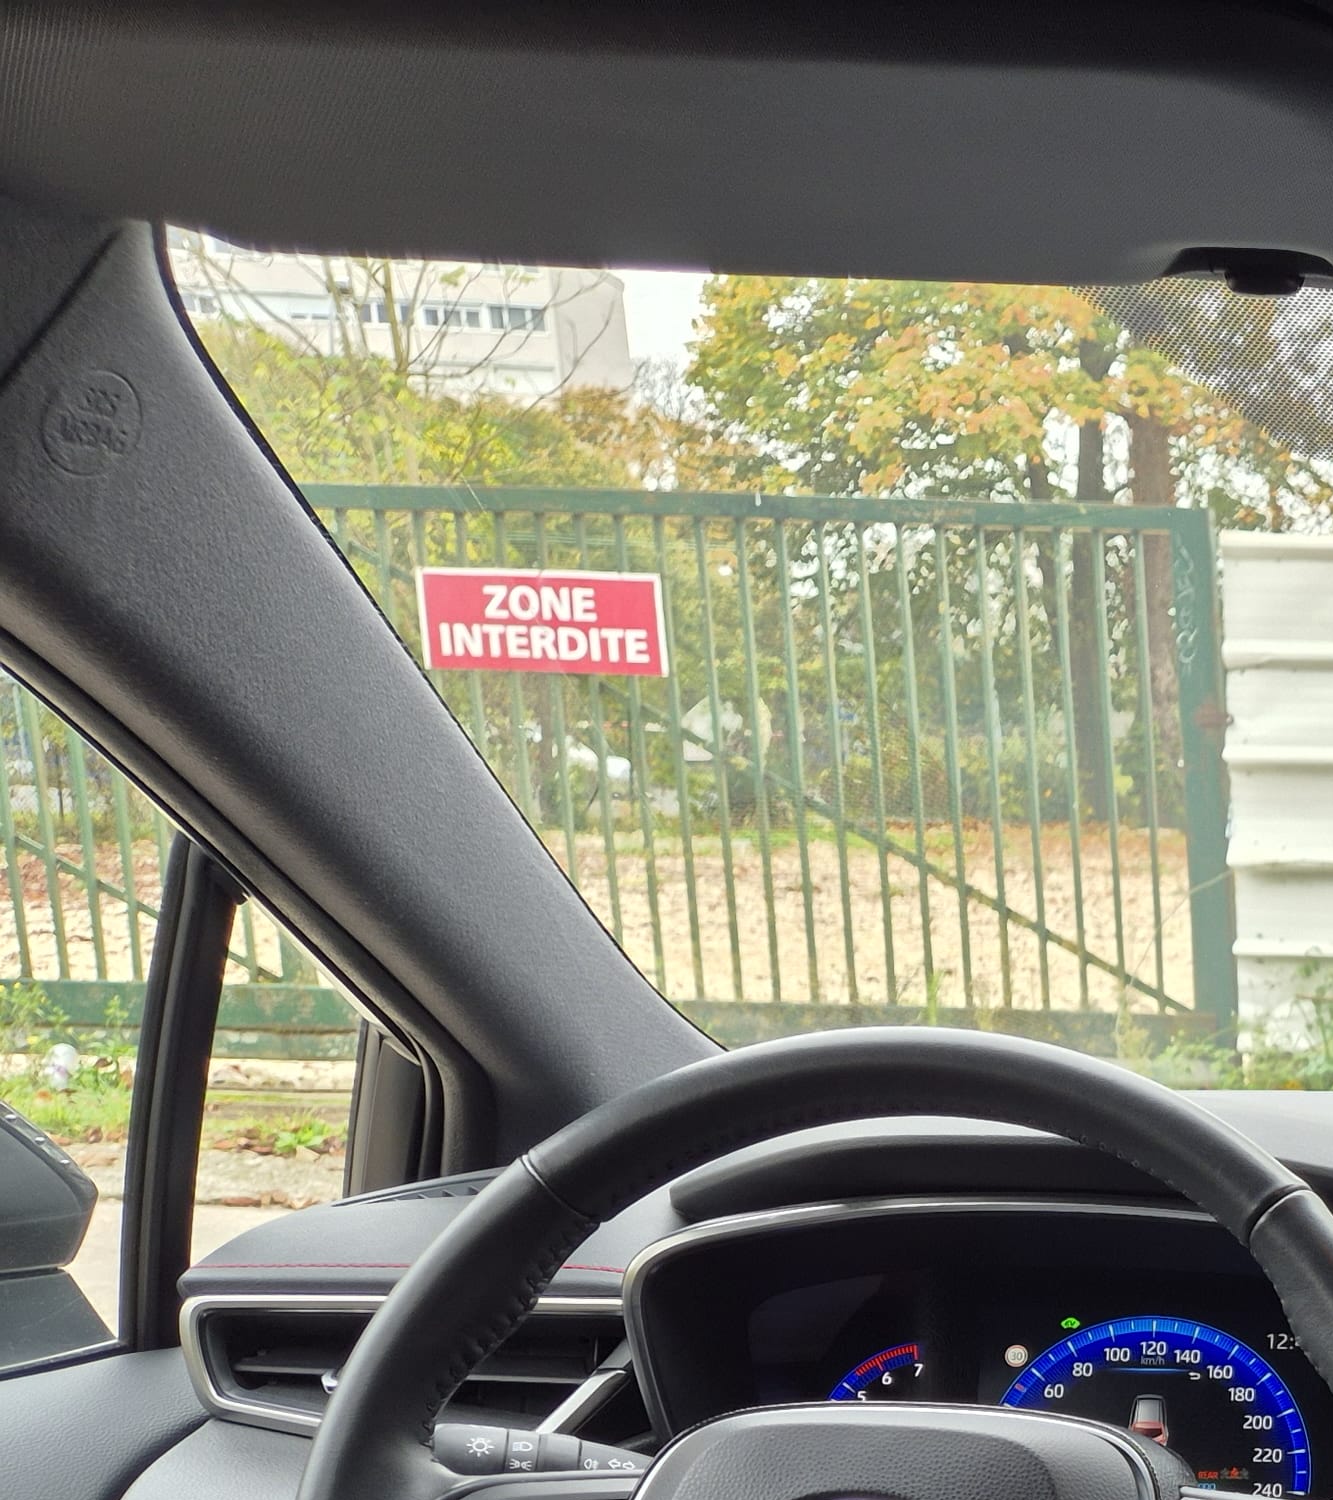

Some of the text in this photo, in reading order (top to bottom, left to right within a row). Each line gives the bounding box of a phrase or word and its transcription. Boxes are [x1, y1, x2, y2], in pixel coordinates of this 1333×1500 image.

[482, 584, 598, 622] ZONE
[439, 622, 650, 663] INTERDITE
[1010, 1351, 1024, 1361] 30
[1103, 1347, 1131, 1362] 100
[1140, 1341, 1167, 1356] 120
[1140, 1354, 1166, 1365] km/h
[1174, 1349, 1201, 1364] 140
[914, 1363, 924, 1377] 7
[1072, 1362, 1093, 1377] 80
[1207, 1365, 1233, 1379] 160
[881, 1371, 892, 1385] 6
[1043, 1383, 1064, 1398] 60
[1228, 1387, 1255, 1402] 180
[1242, 1415, 1273, 1430] 200
[1252, 1448, 1282, 1463] 220
[1252, 1482, 1283, 1498] 240
